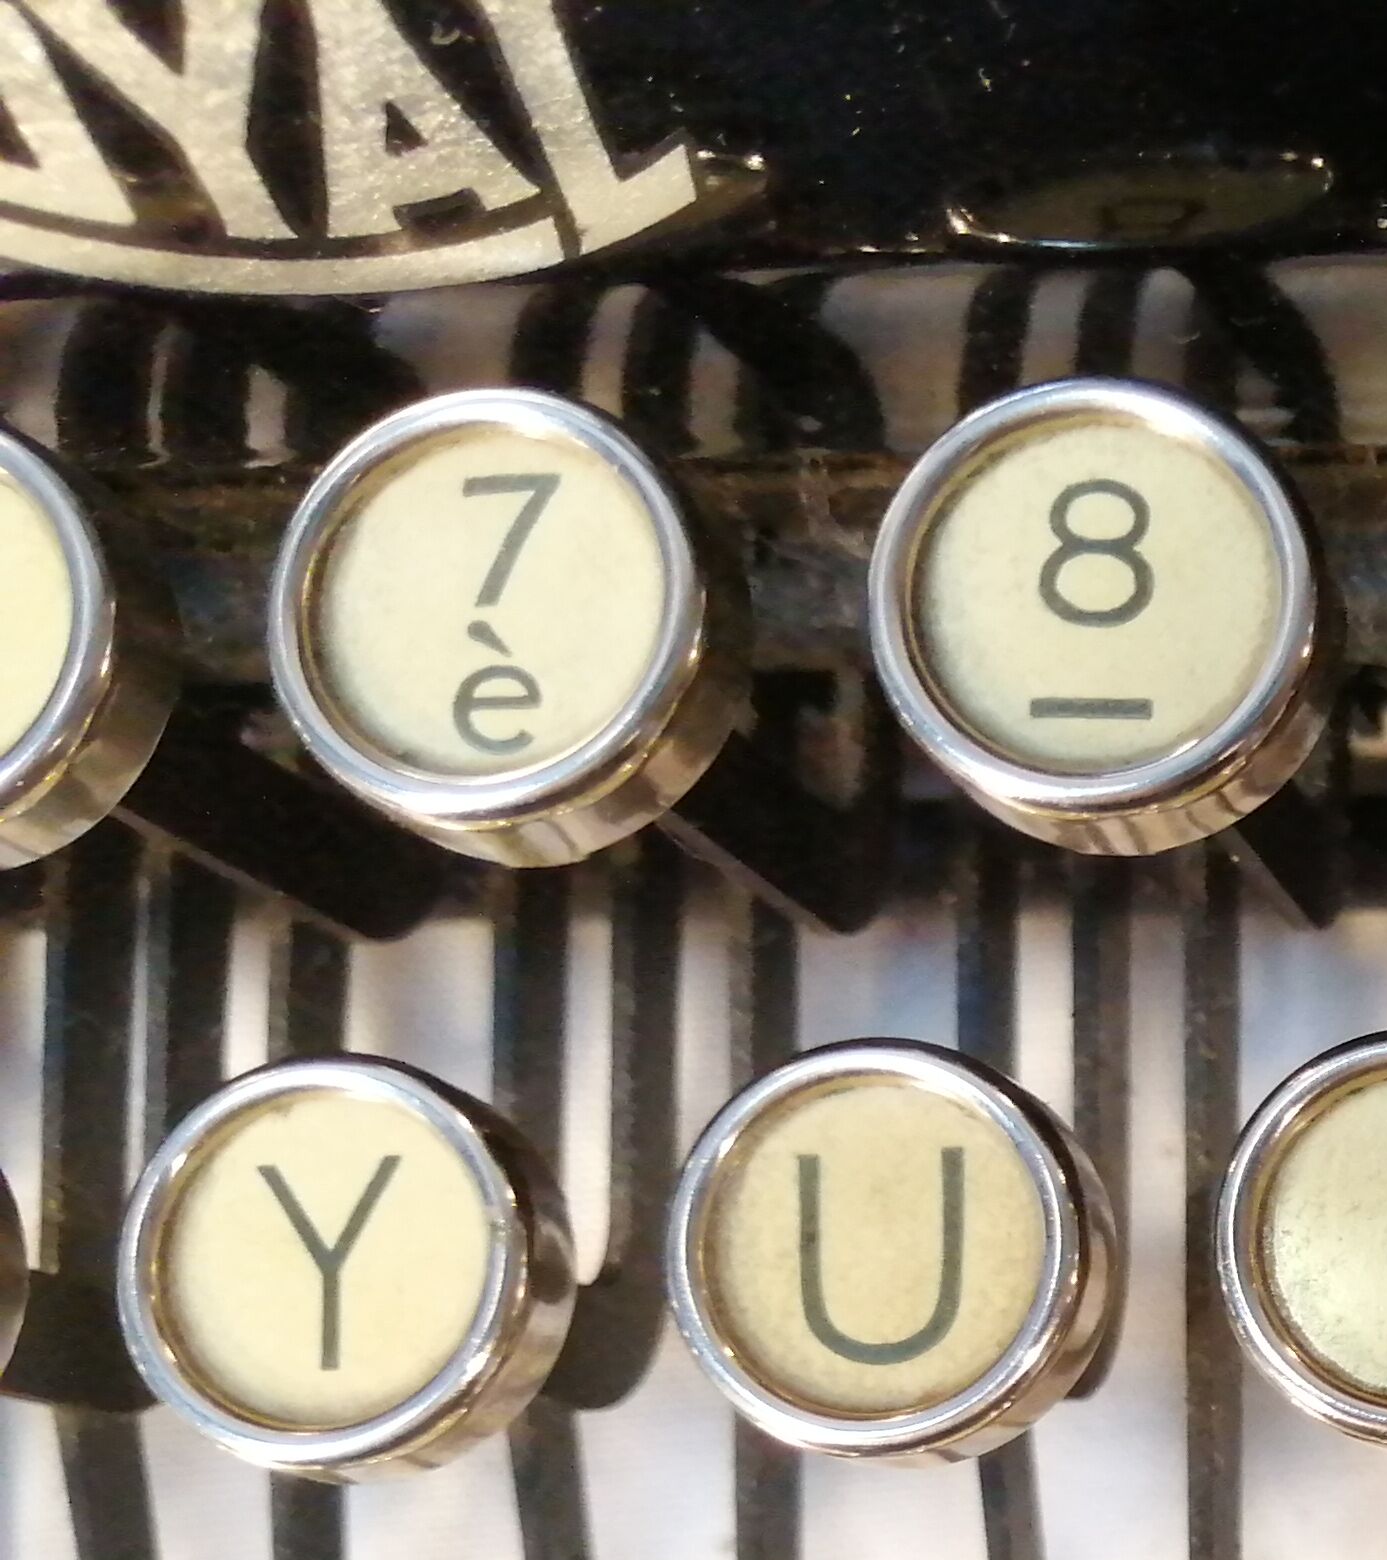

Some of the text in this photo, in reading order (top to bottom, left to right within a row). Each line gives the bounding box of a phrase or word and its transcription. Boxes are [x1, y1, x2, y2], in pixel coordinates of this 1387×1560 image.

[0, 0, 697, 256] YAL
[462, 472, 561, 608] 7
[1038, 478, 1155, 628] 8
[453, 619, 542, 756] è
[257, 1154, 402, 1372] Y
[797, 1146, 965, 1366] U
